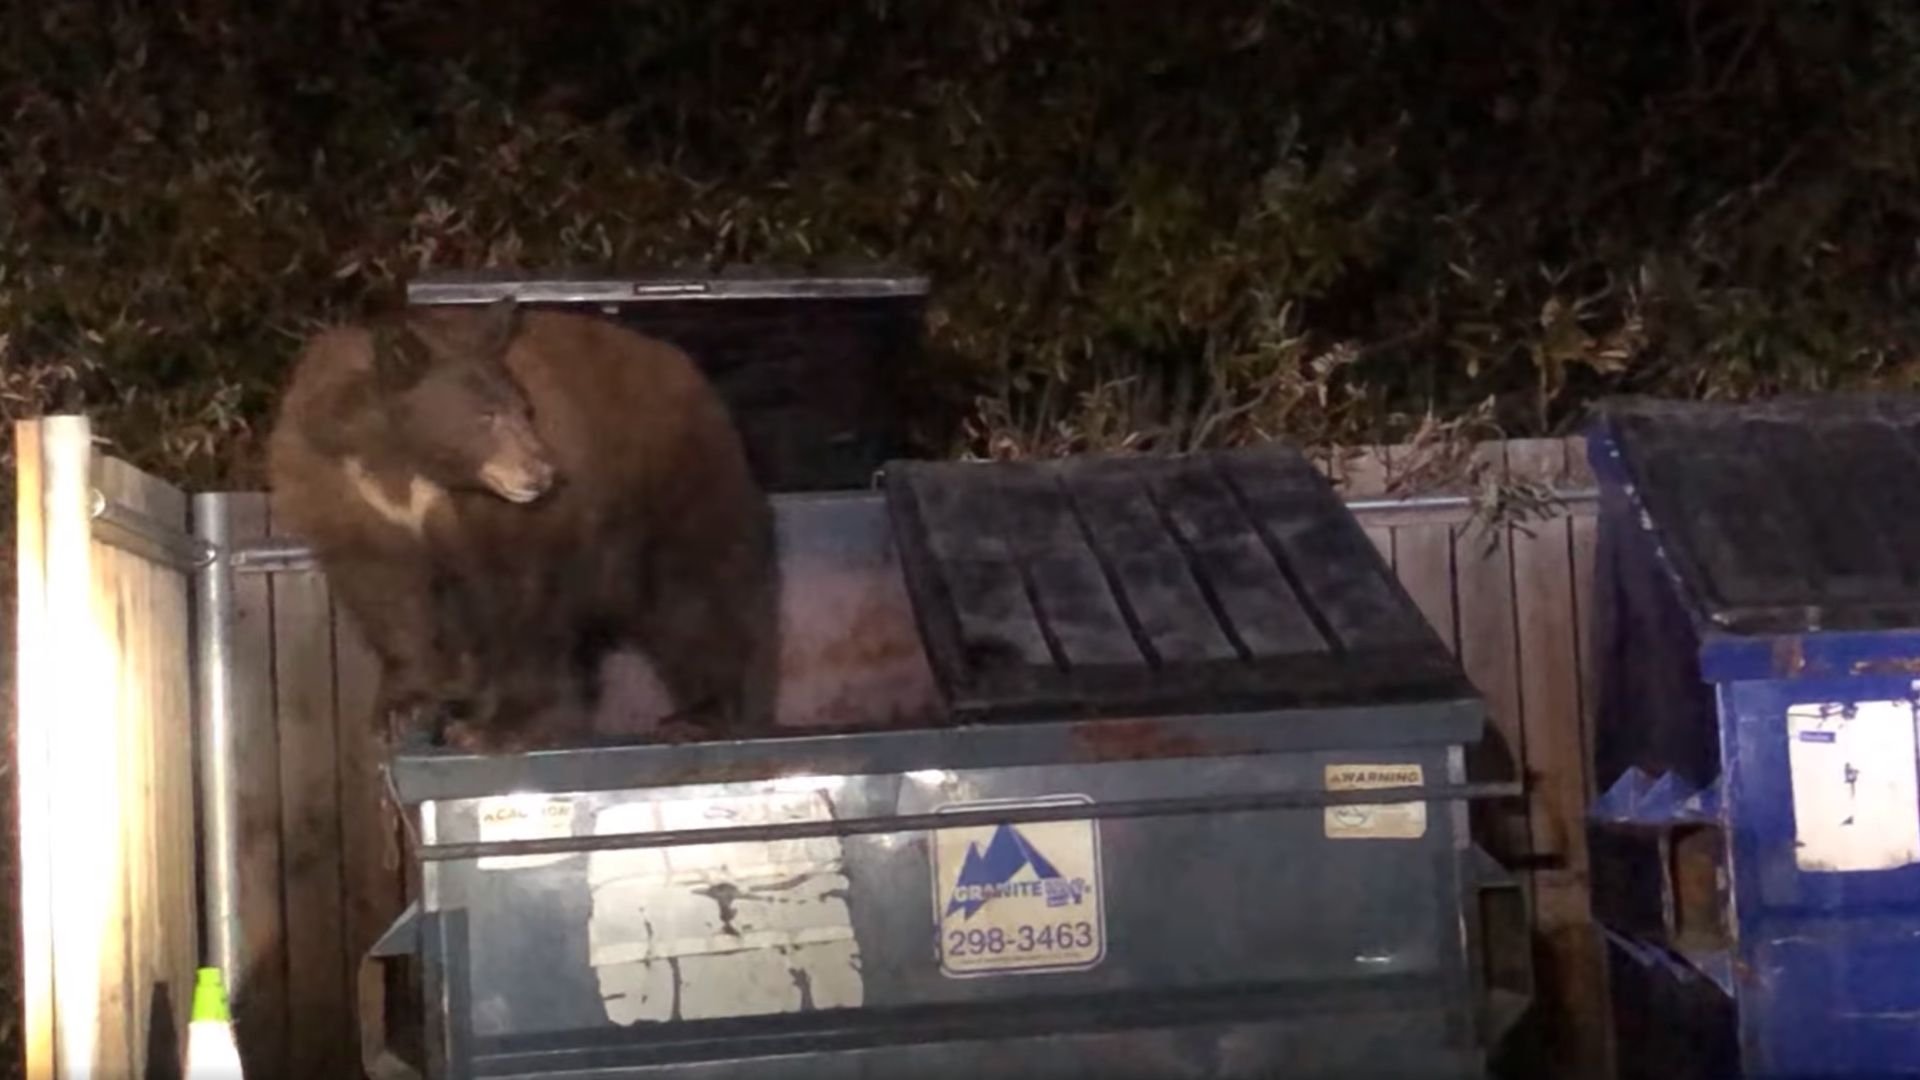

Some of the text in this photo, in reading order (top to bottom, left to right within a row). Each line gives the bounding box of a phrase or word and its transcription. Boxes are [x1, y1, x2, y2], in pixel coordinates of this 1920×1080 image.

[1341, 771, 1420, 783] WARNING
[496, 805, 571, 821] CAUION
[955, 881, 1043, 902] GRANITE
[949, 921, 1093, 956] 298-3463
